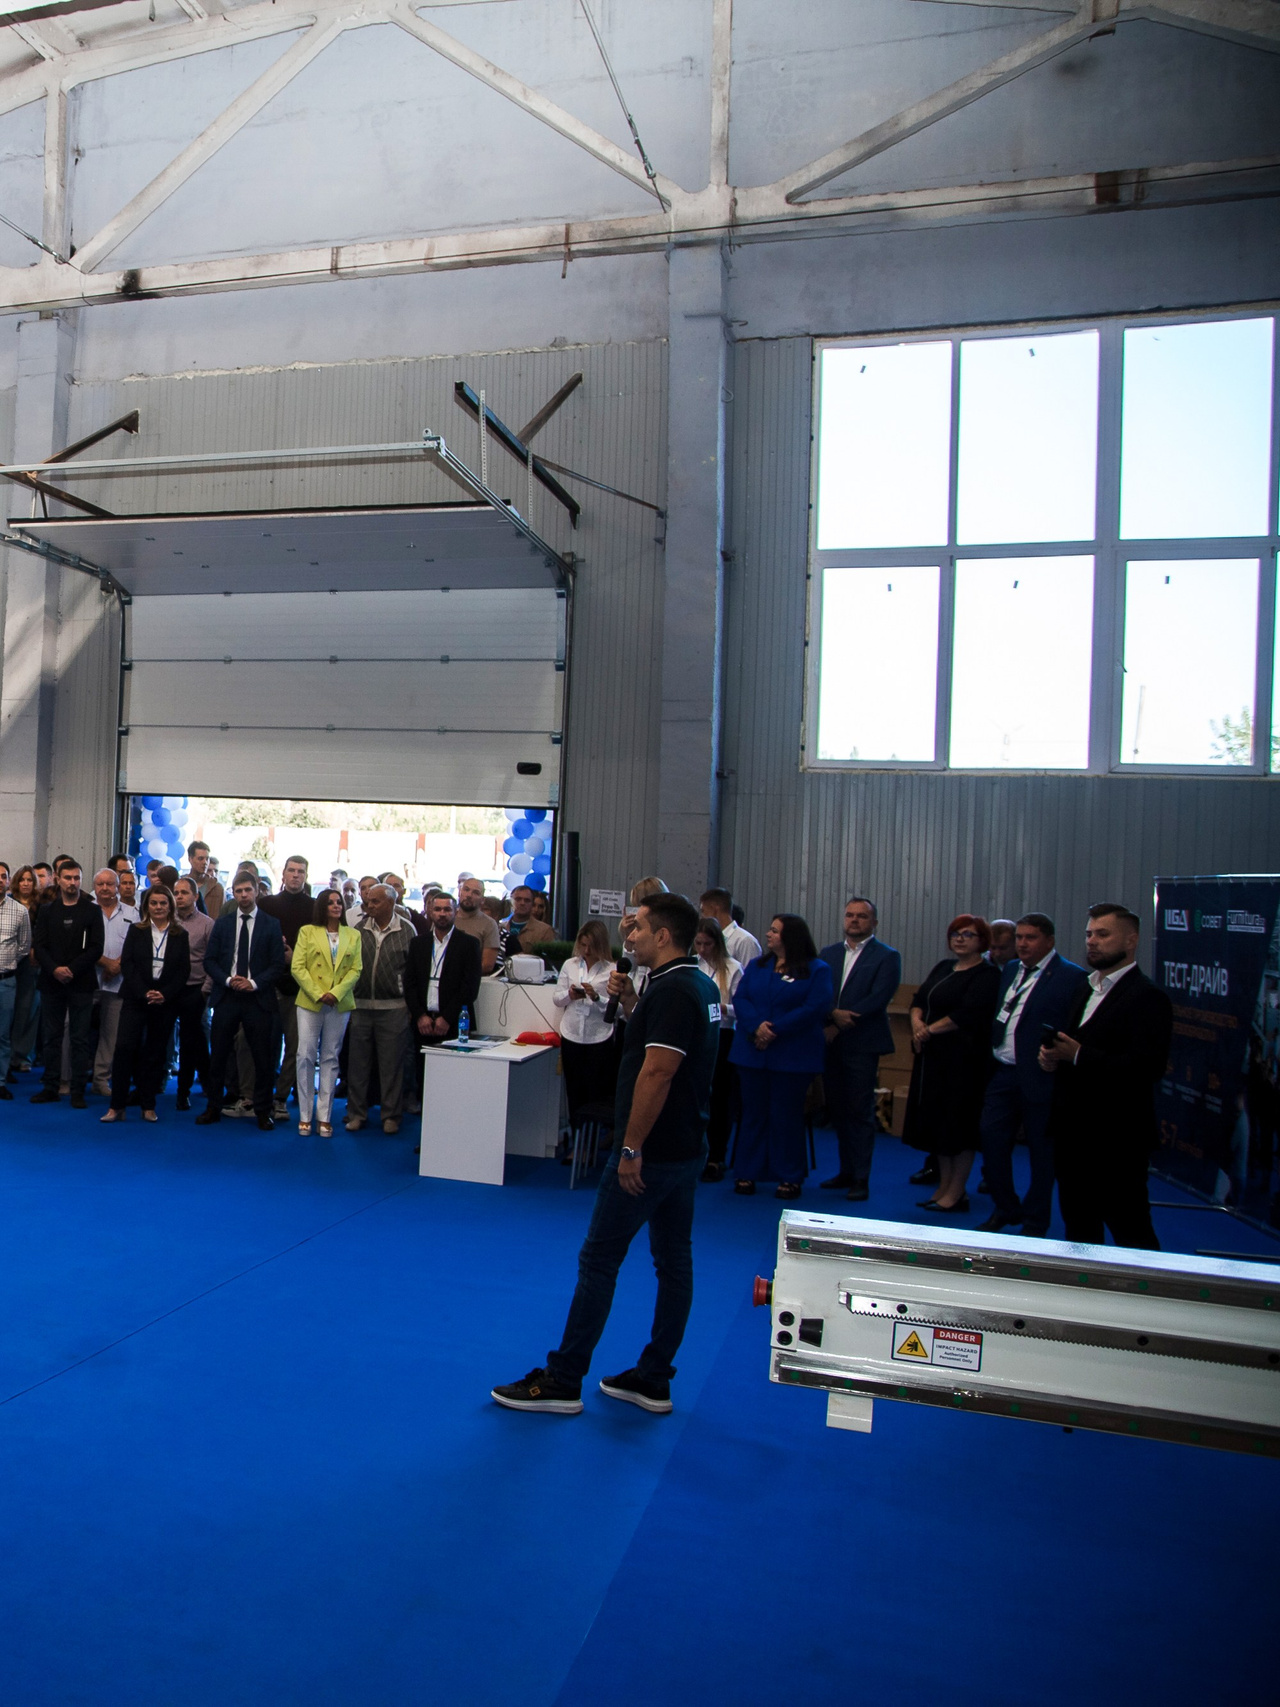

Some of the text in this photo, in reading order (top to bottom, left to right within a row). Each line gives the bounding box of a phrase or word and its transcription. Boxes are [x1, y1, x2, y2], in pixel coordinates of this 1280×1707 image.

[1165, 909, 1188, 931] LIGA
[1164, 961, 1229, 997] ТЕСТ-ДРАЙВ
[939, 1330, 976, 1342] DANGER
[956, 1346, 978, 1354] HAZARD
